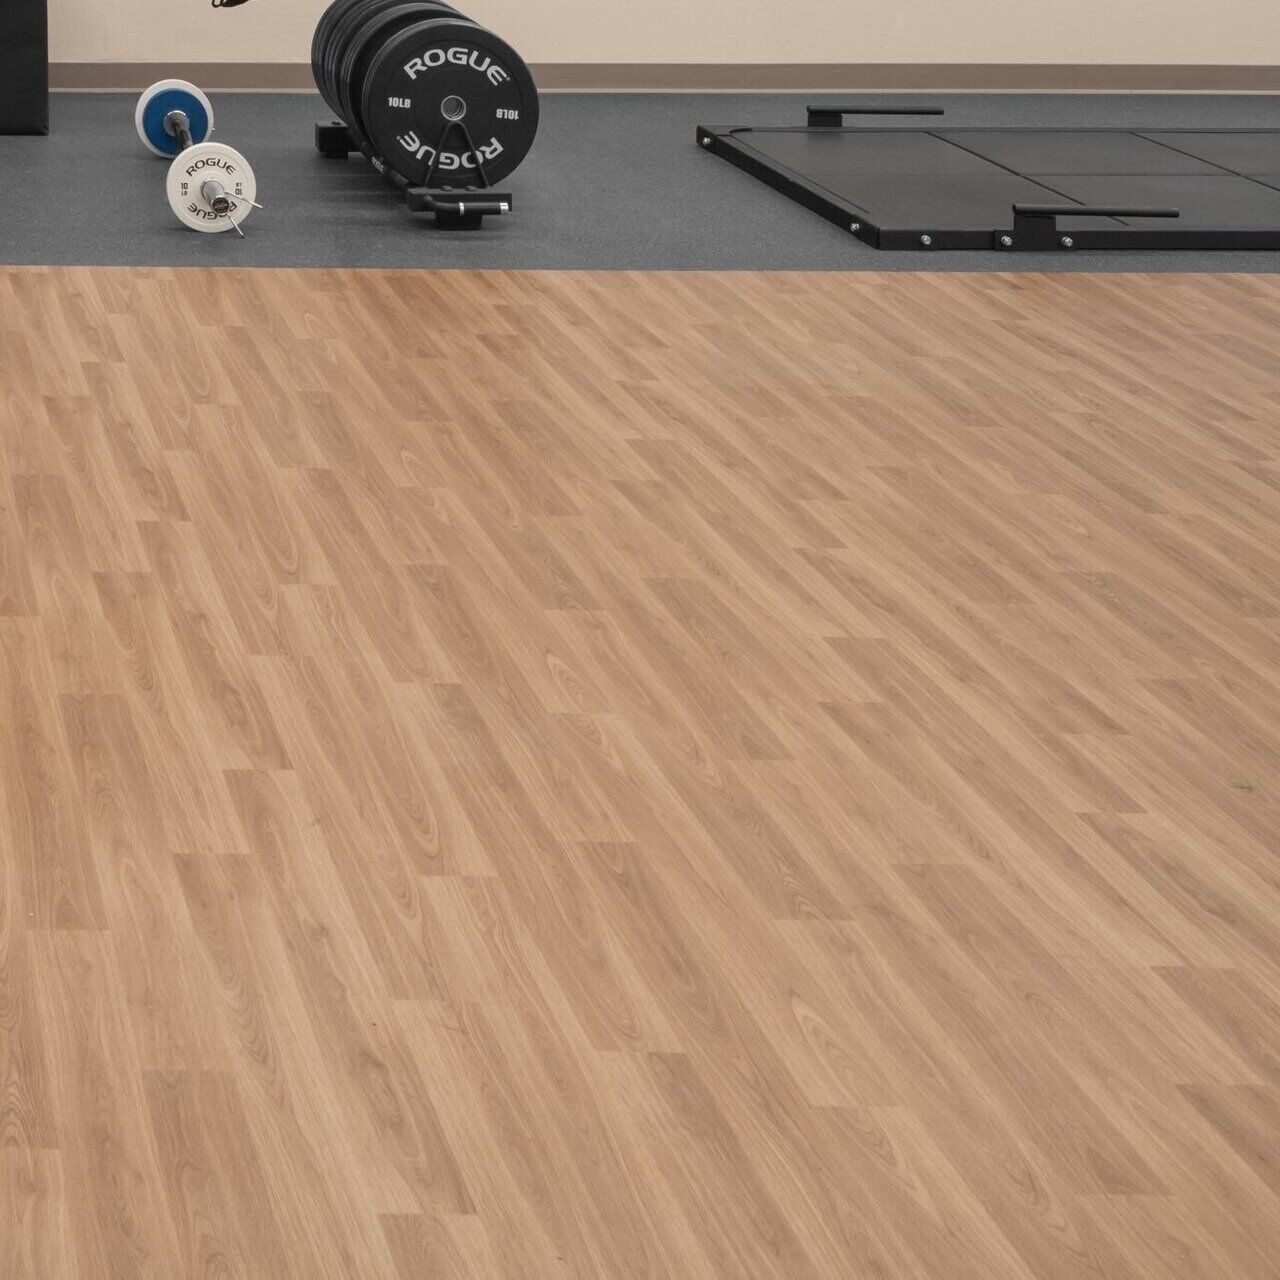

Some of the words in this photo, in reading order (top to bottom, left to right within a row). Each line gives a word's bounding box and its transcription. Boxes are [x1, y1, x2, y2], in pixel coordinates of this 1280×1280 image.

[404, 47, 507, 86] ROGUE
[388, 97, 411, 109] 10LB
[496, 108, 519, 120] 10LB
[401, 131, 504, 170] ROGUE
[186, 158, 236, 177] ROGUE
[188, 202, 237, 220] RGUE
